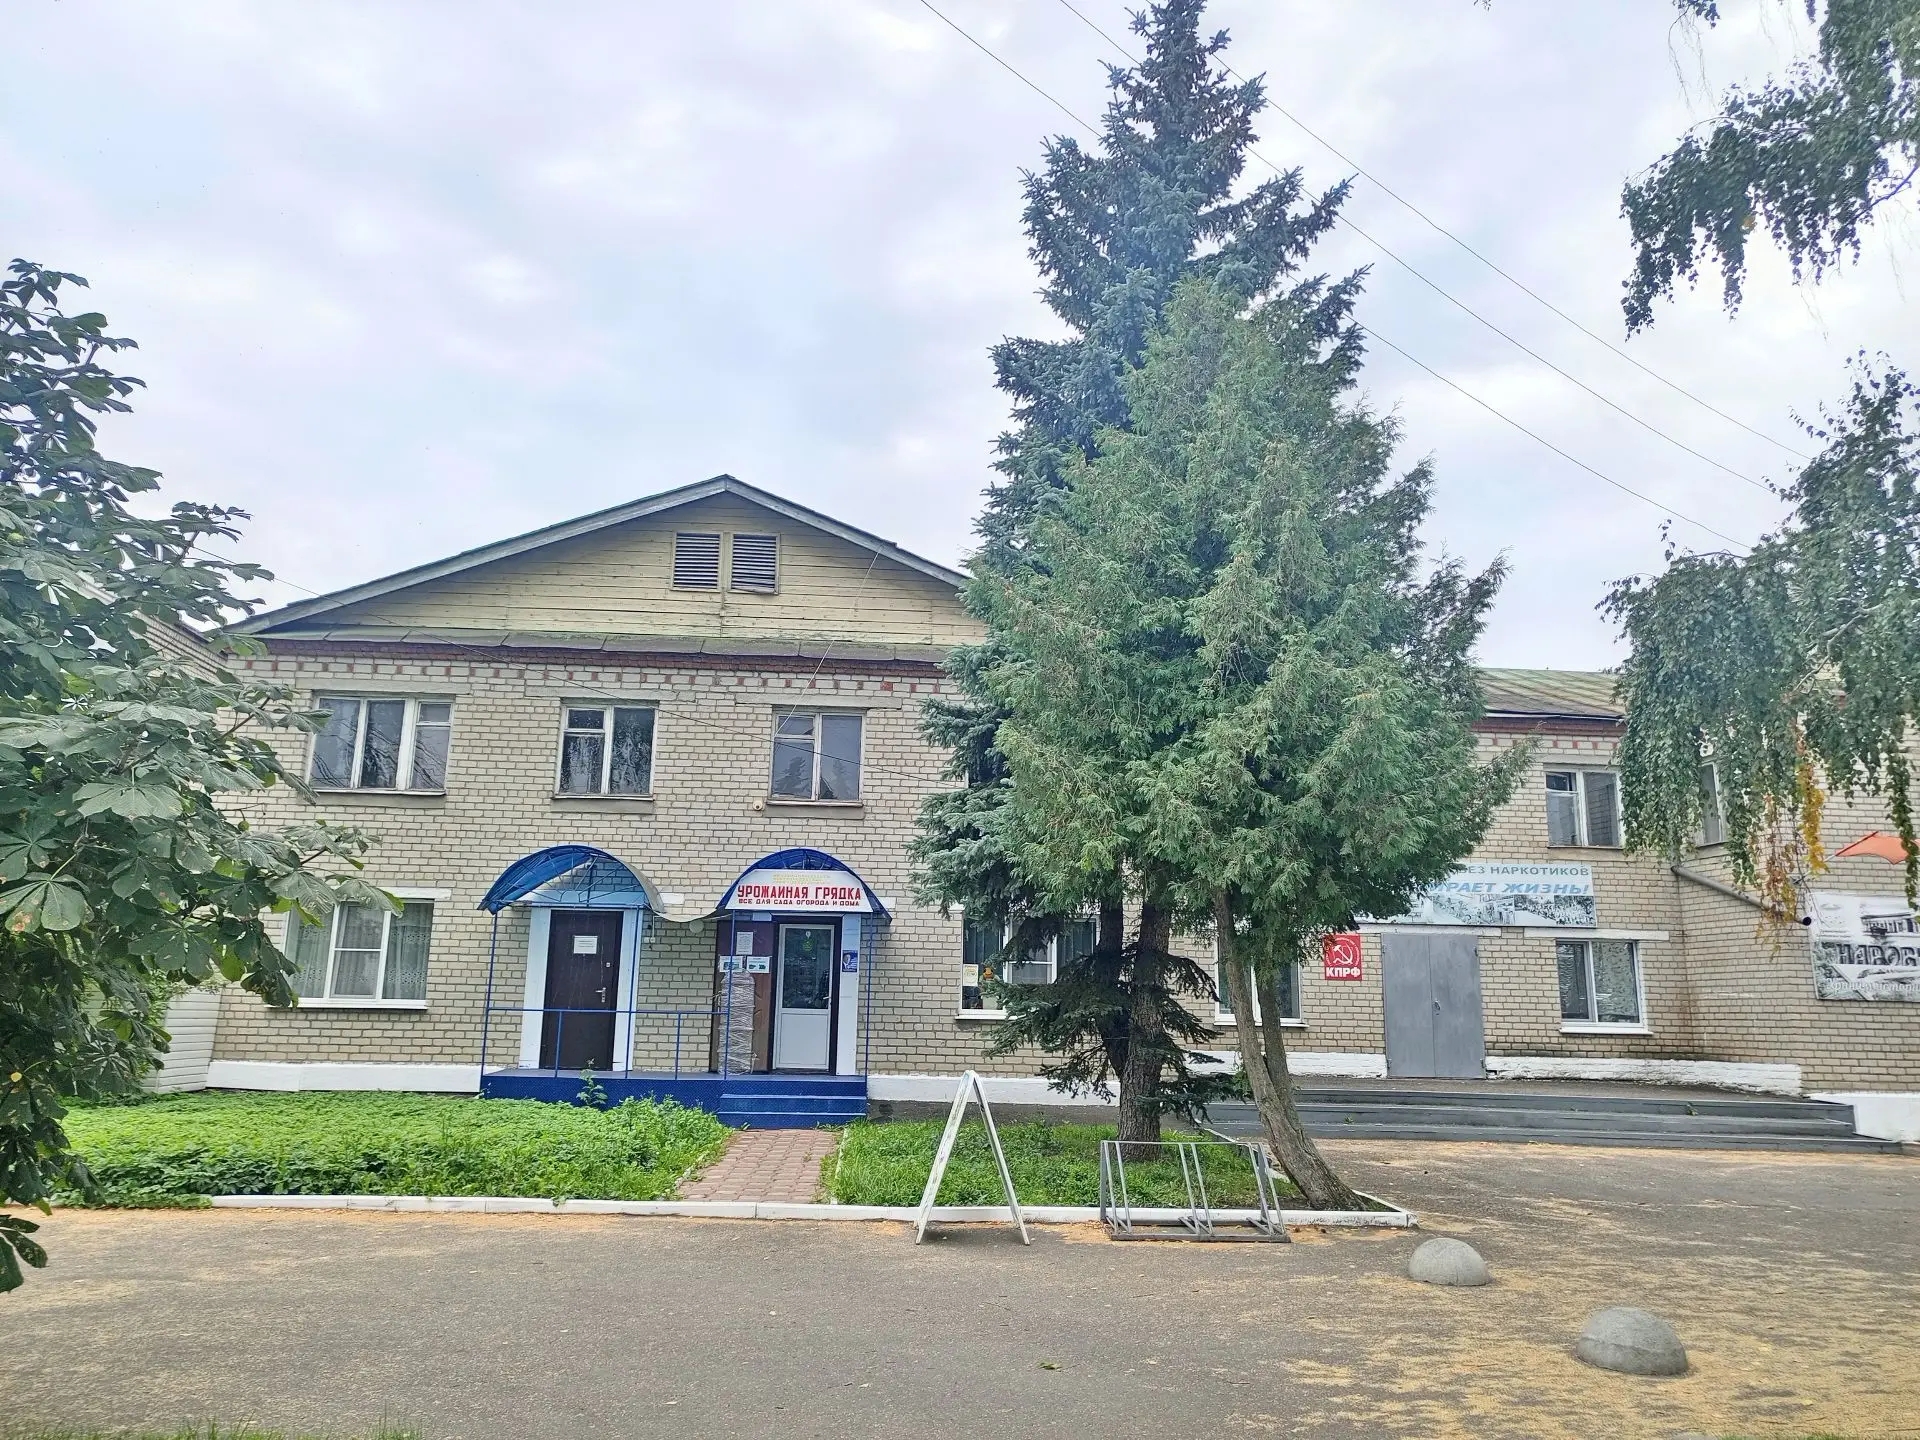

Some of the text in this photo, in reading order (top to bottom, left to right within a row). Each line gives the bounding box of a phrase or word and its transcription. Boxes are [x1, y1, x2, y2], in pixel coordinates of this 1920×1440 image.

[1490, 867, 1589, 876] НАРКОТИКОВ
[815, 886, 862, 900] ГРЯДКА
[1428, 882, 1589, 895] ИРАЕТ ЖИЗНЬ!
[1835, 943, 1920, 967] НАРОВ
[1325, 966, 1361, 978] КПРФ
